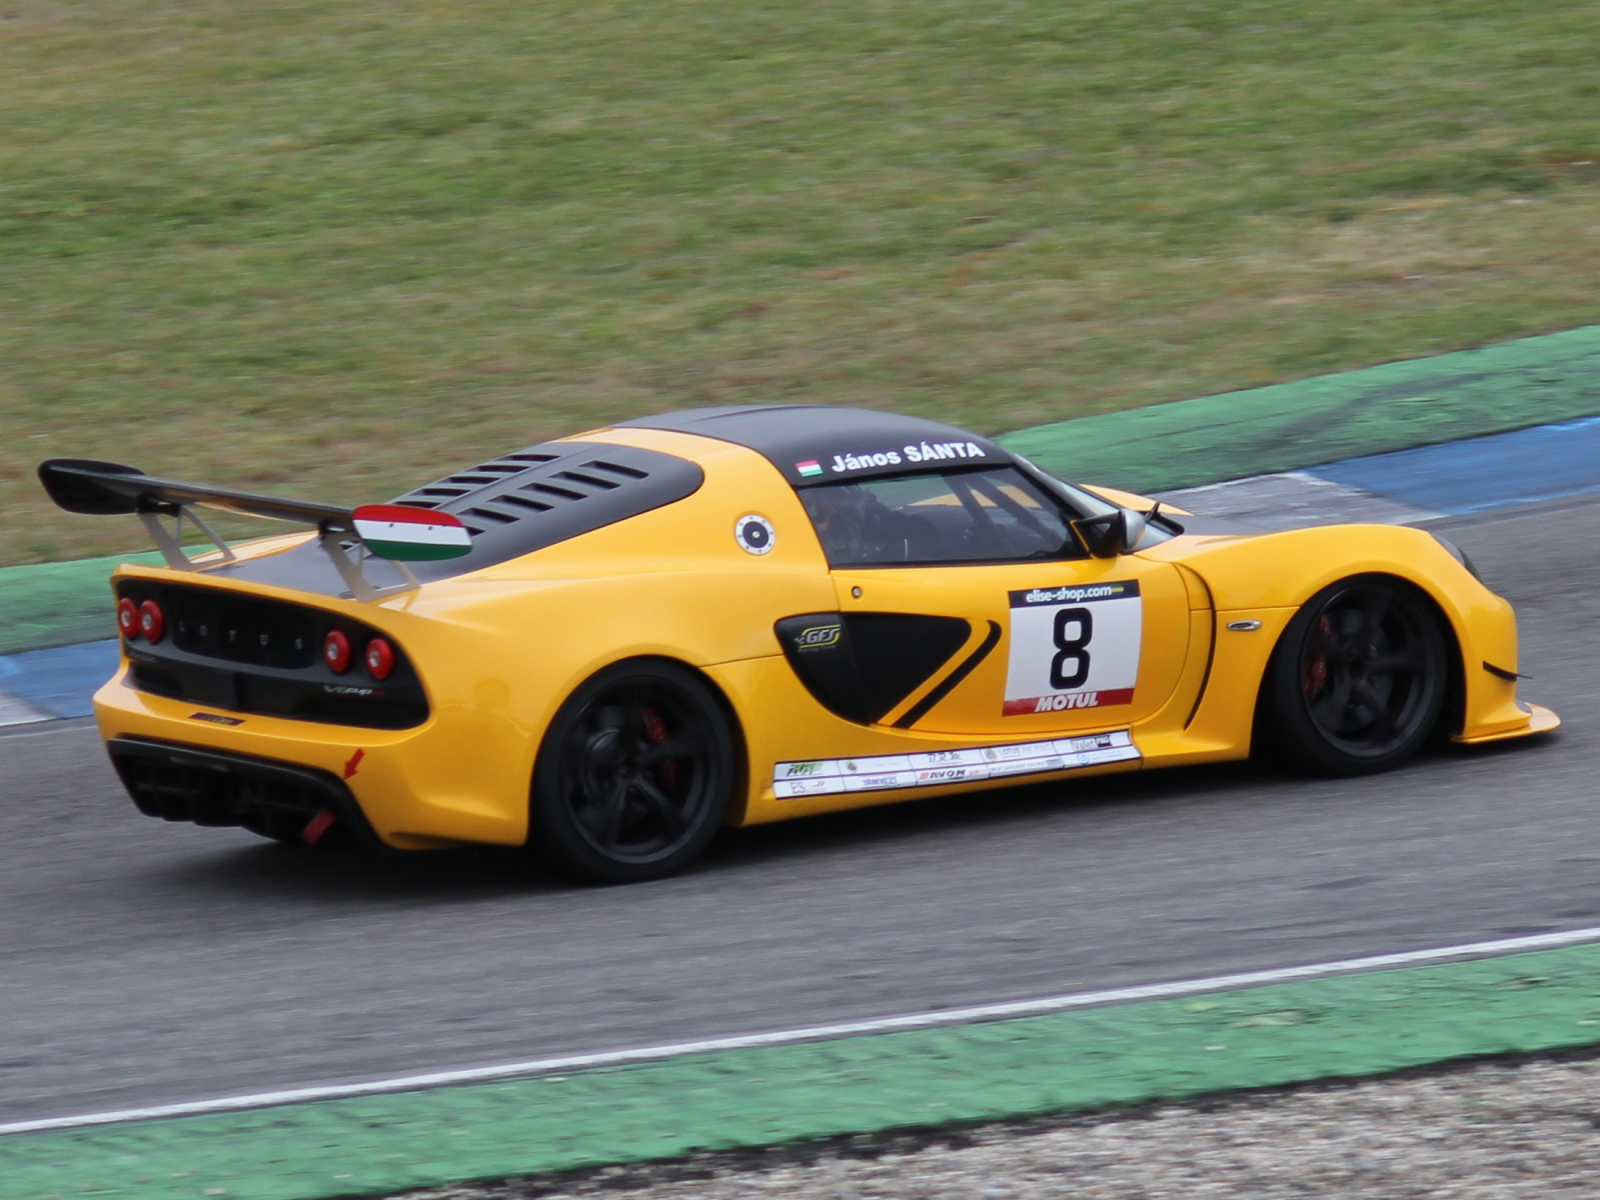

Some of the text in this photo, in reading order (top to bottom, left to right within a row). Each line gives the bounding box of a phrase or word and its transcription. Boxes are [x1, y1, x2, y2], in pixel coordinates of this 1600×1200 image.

[831, 441, 986, 473] János SÁNTA
[1025, 586, 1113, 603] elise-shop.com
[179, 620, 304, 650] LOTUS
[806, 628, 841, 643] GFS
[1049, 607, 1093, 690] 8
[1034, 692, 1099, 713] MOTUL
